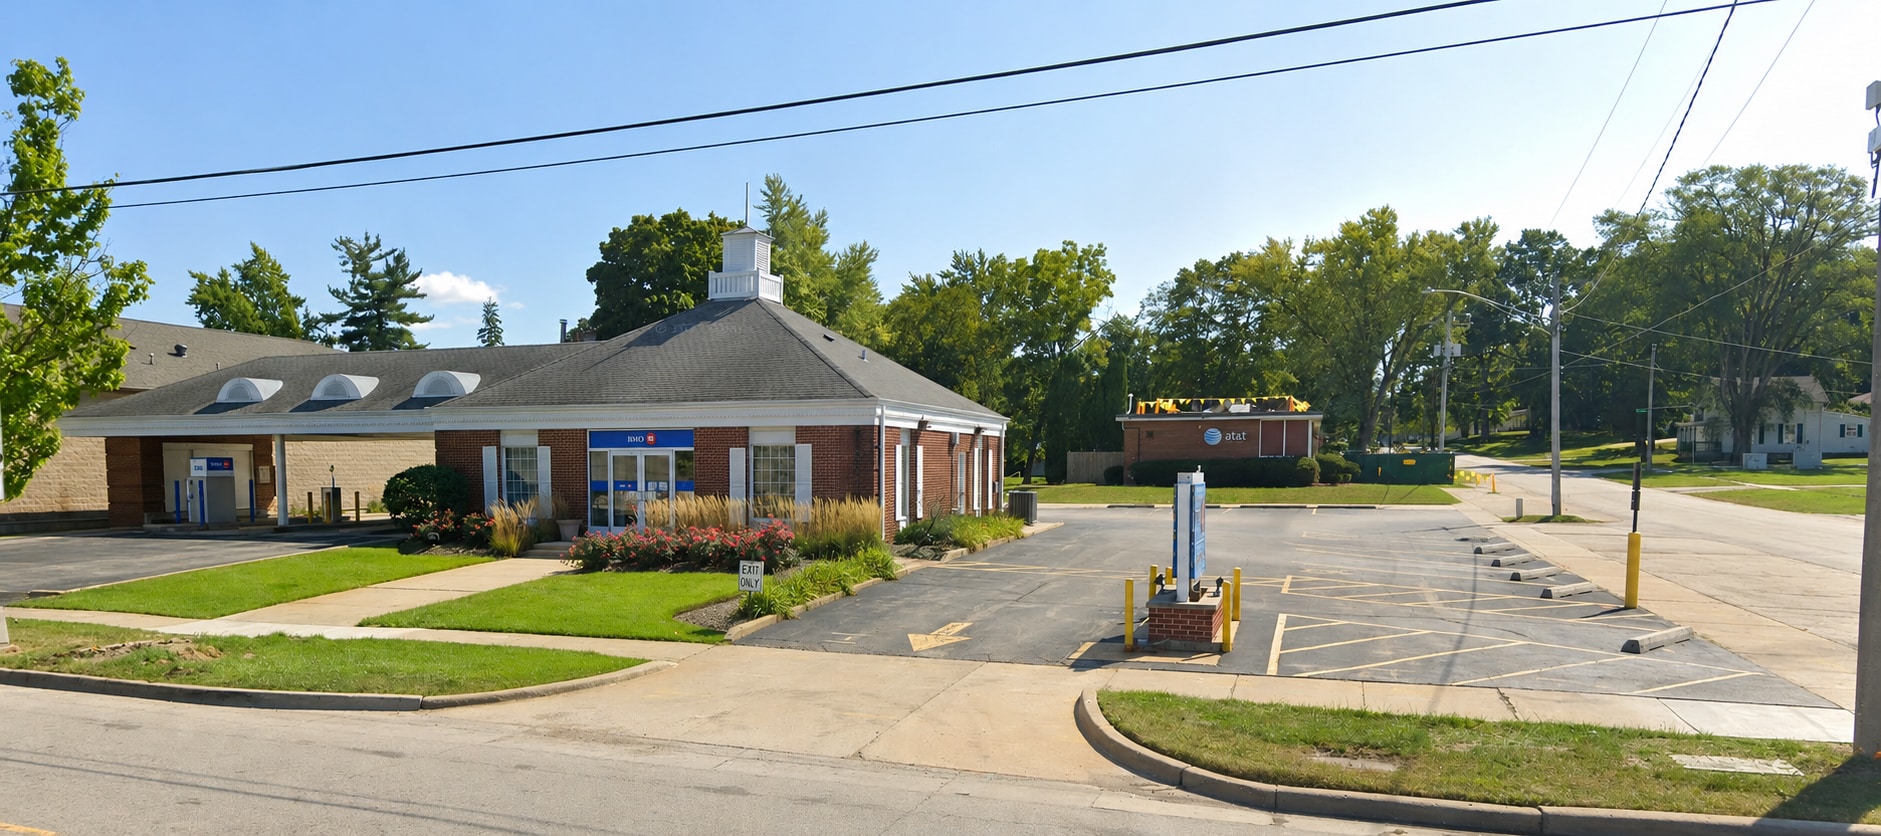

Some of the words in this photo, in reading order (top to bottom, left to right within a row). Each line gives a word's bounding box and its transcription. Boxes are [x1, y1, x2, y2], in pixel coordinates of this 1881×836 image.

[627, 435, 645, 443] BMO
[742, 564, 760, 575] EXIT
[740, 577, 760, 588] ONLY
